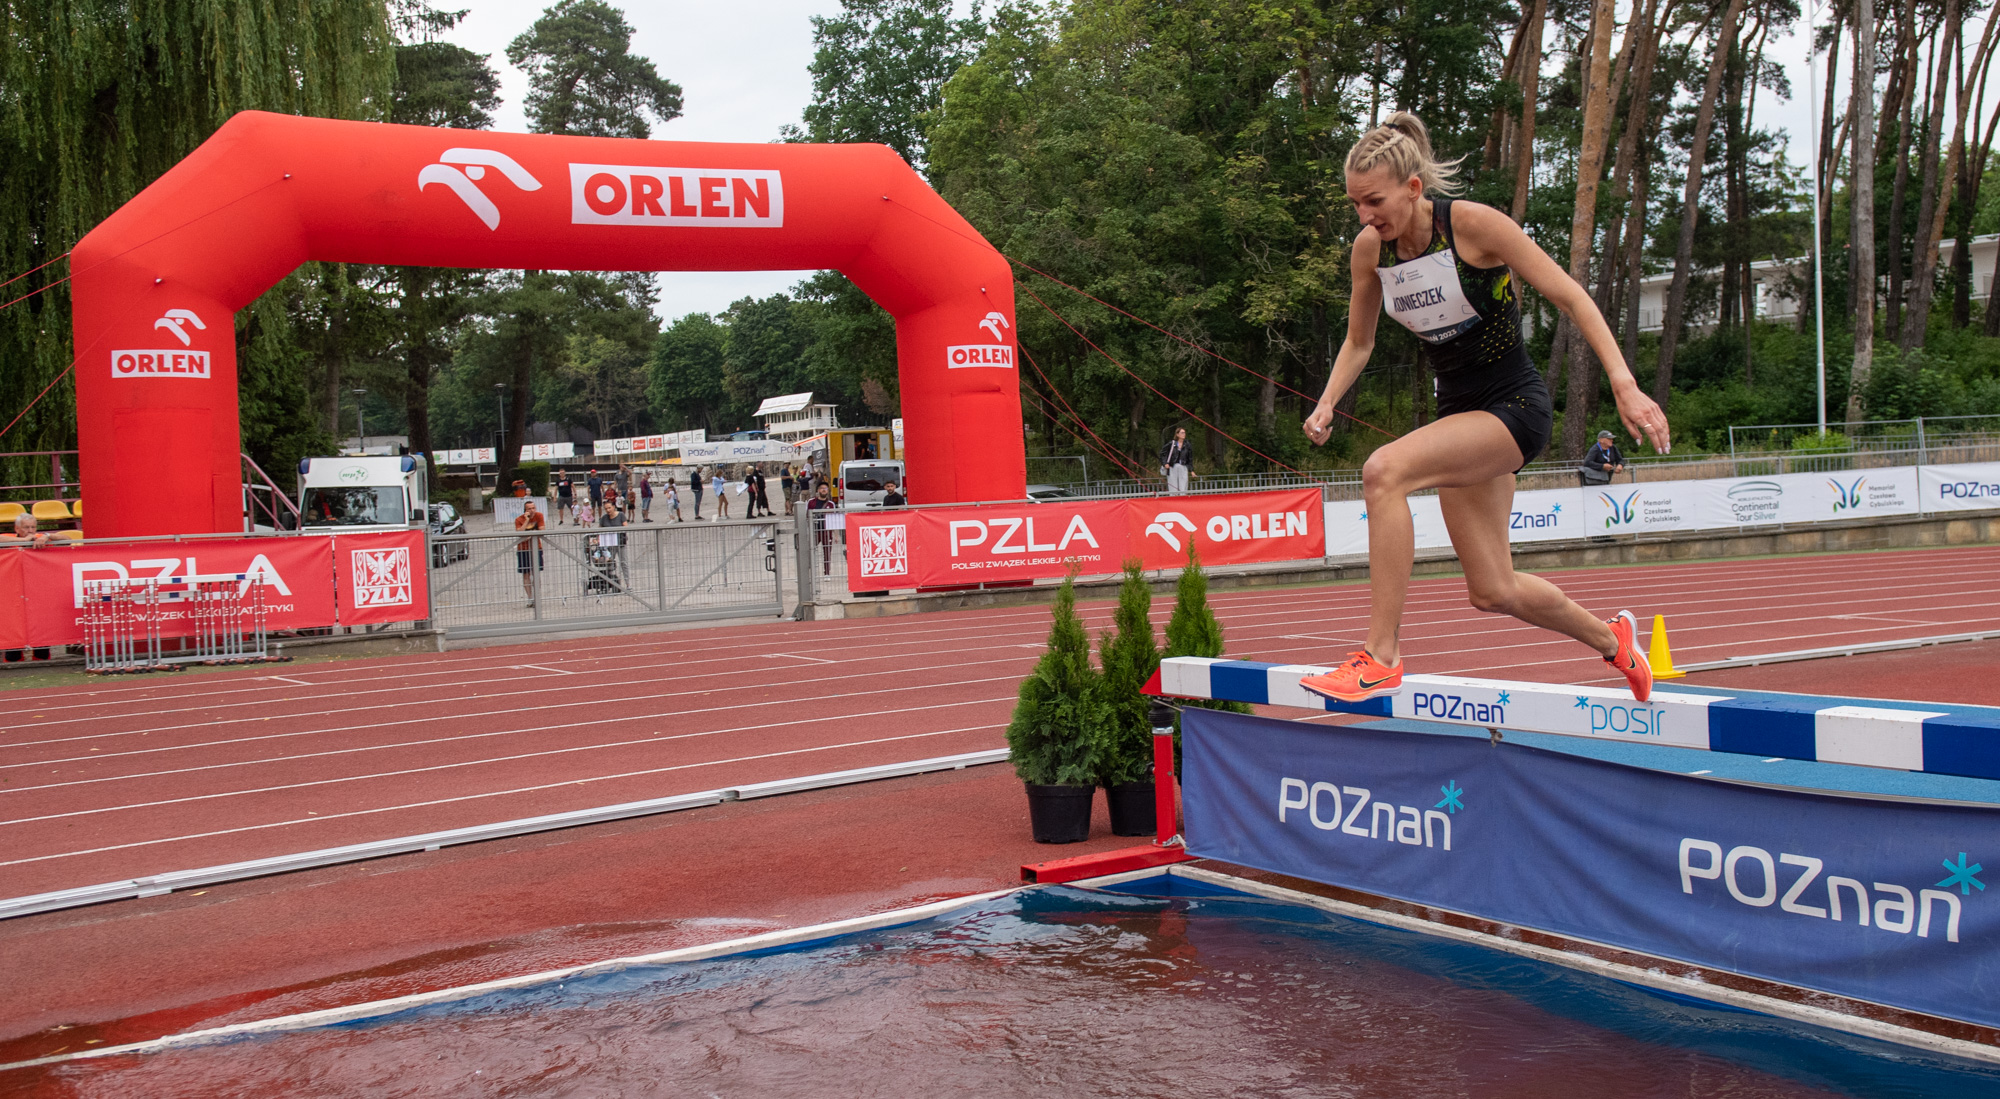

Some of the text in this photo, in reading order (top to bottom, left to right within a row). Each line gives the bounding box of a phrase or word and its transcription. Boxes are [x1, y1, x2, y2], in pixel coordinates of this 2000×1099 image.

[584, 172, 770, 219] ORLEN
[1438, 328, 1458, 341] 2023
[117, 353, 205, 374] ORLEN
[952, 348, 1010, 365] ORLEN
[1731, 501, 1780, 512] Continental
[1644, 515, 1681, 523] Cybulskiego
[1735, 511, 1776, 521] Tour Silver
[1206, 510, 1308, 542] ORLEN
[950, 514, 1100, 557] PZLA
[864, 558, 905, 575] PZLA
[951, 561, 984, 570] POLSKI
[986, 559, 1026, 568] ZWIĄZEK
[1027, 557, 1061, 566] LEKKIEJ
[72, 553, 293, 609] PZLA
[357, 586, 409, 605] PZLA
